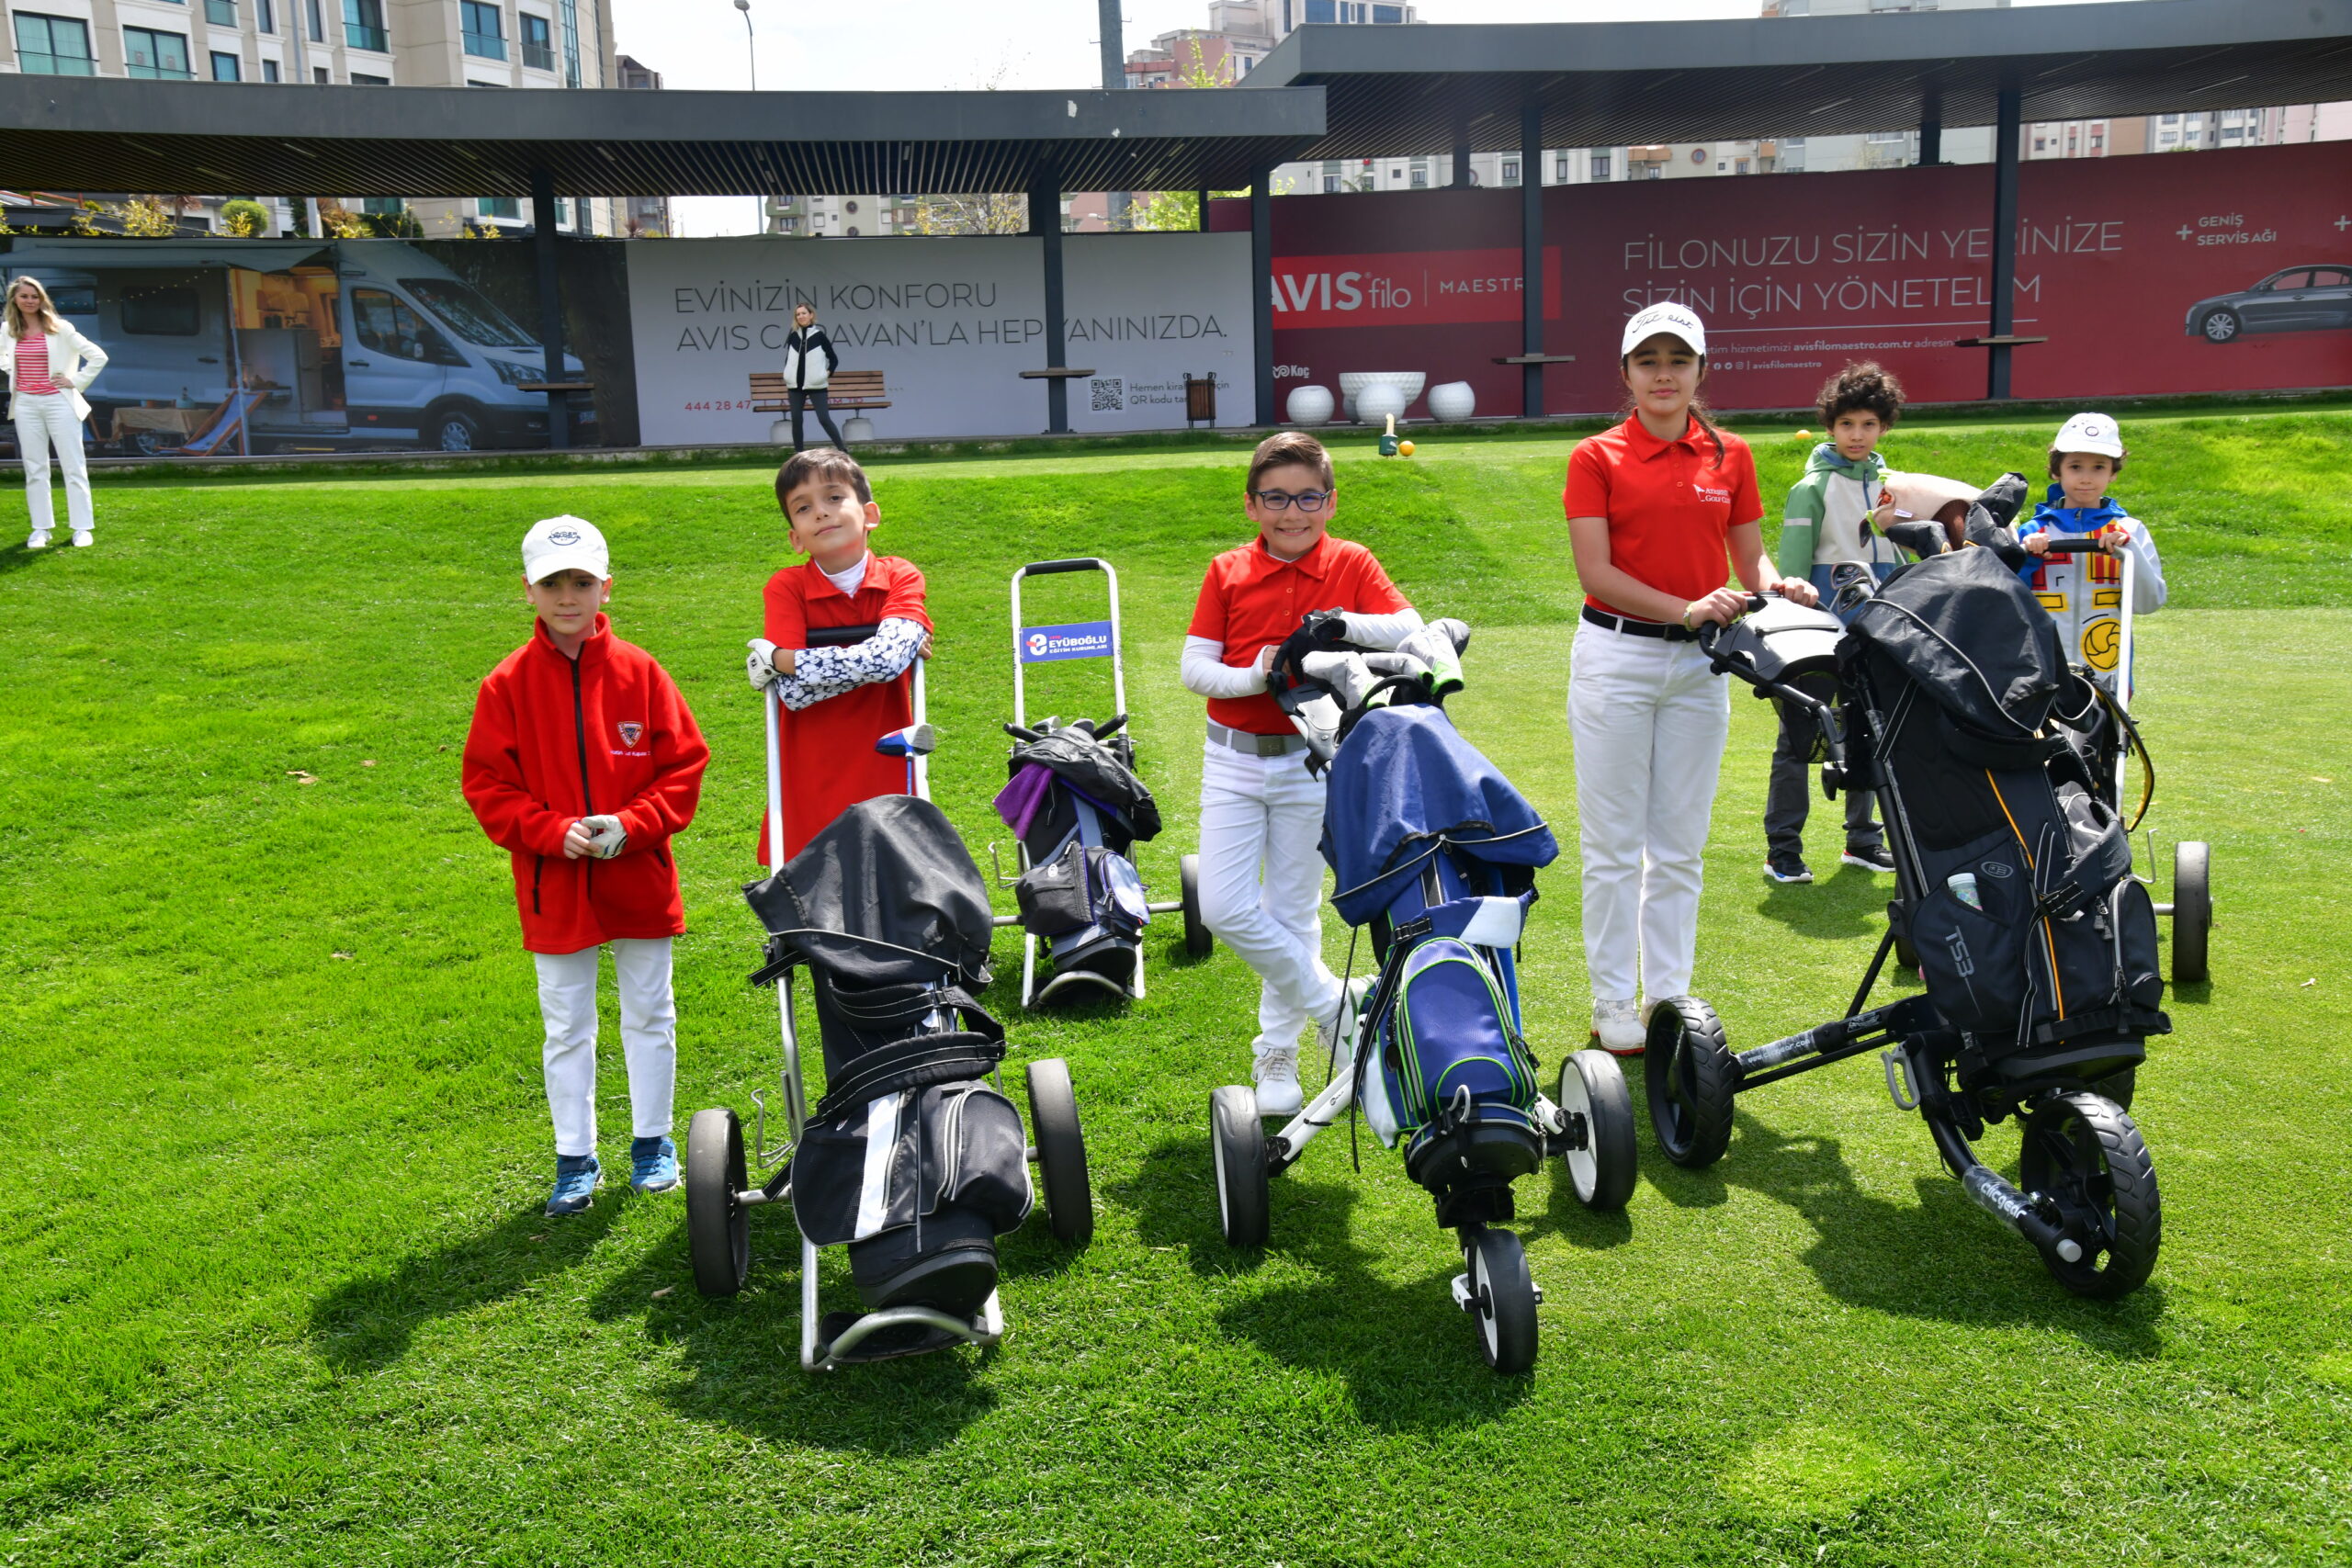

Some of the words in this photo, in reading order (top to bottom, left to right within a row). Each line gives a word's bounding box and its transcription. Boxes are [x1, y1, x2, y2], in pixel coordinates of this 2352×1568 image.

[2198, 212, 2245, 228] GENİŞ
[1624, 232, 1819, 270] FİLONUZU
[1832, 223, 1928, 264] SİZİN
[1940, 215, 2124, 259] YEİNİZE
[2197, 230, 2249, 246] SERVİS
[2251, 228, 2277, 243] AĞI
[674, 278, 818, 313] EVİNİZİN
[830, 282, 997, 310] KONFORU
[1368, 277, 1411, 309] filo
[1440, 276, 1524, 294] MAESTR
[1623, 279, 1715, 318] SİZİN
[1729, 276, 1802, 320] İÇİN
[1814, 274, 2041, 310] YÖNETELM
[1632, 310, 1694, 333] Titeist
[676, 324, 750, 352] AVIS
[760, 320, 969, 351] CAVAN'LA
[978, 320, 1043, 344] HEP
[1731, 342, 1792, 355] hizmetimizi
[1793, 339, 1913, 351] avisfilomaestro.com.tr
[1752, 359, 1822, 369] avisfilomaestro
[1129, 382, 1165, 392] Hemen
[684, 400, 710, 412] 444
[716, 400, 731, 411] 28
[736, 400, 752, 410] 47
[1130, 395, 1148, 404] QR
[1149, 394, 1172, 404] kodu
[1048, 635, 1107, 649] EYÜBOĞLU
[1980, 1182, 2028, 1219] clicgear
